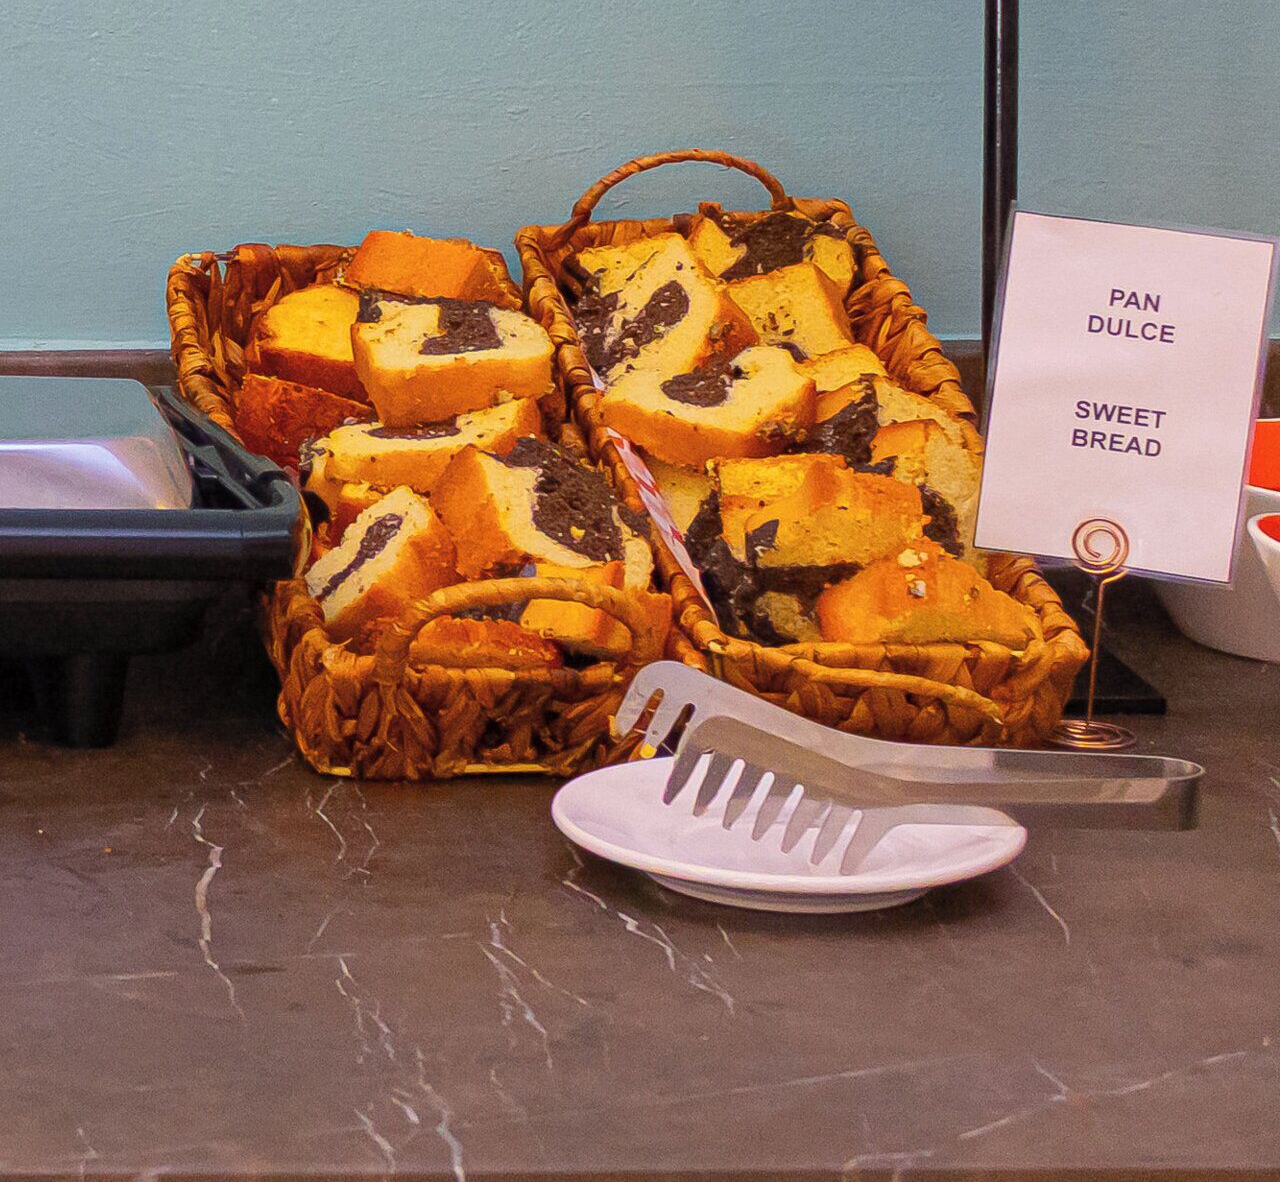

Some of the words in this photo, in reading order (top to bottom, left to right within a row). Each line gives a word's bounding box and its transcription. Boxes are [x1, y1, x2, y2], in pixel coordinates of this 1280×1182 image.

[1110, 289, 1160, 312] PAN
[1088, 315, 1175, 343] DULCE
[1075, 401, 1166, 429] SWEET
[1072, 429, 1161, 456] BREAD
